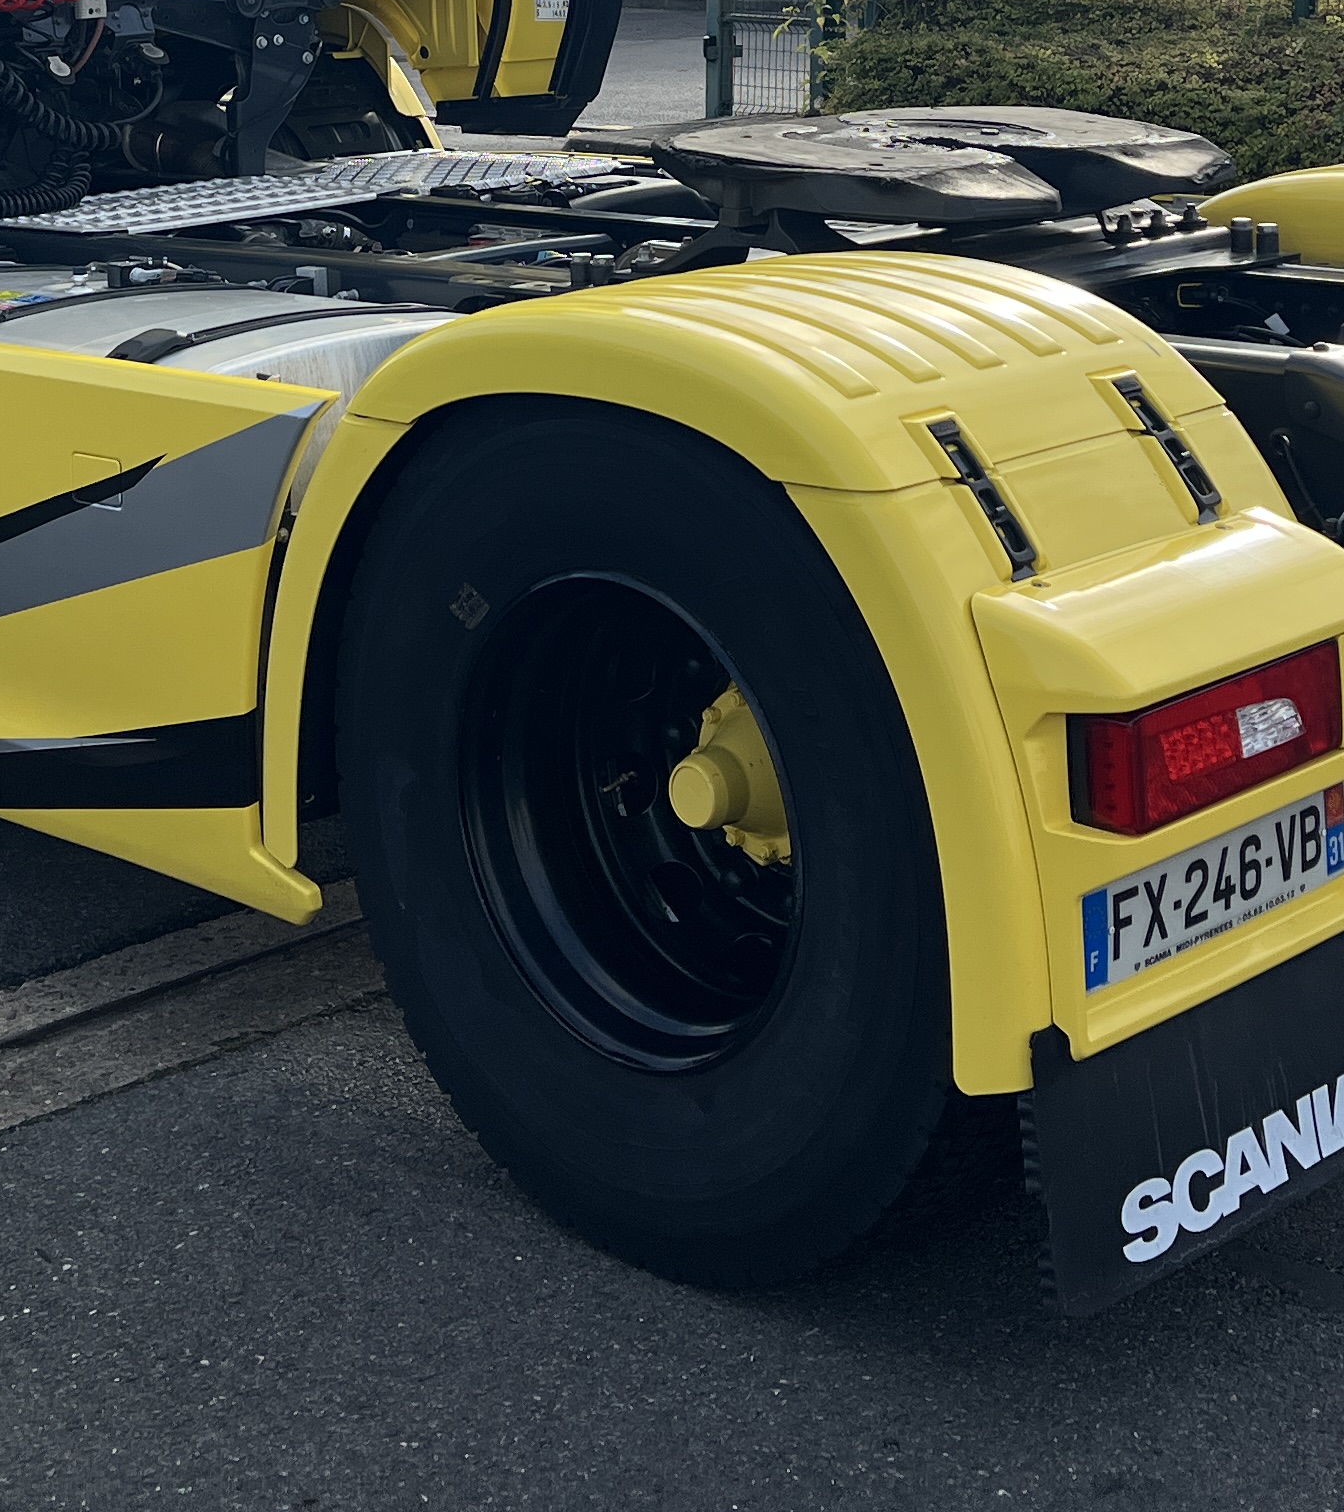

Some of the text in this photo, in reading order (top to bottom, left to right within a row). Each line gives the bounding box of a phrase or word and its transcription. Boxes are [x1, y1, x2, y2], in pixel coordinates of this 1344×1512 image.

[1090, 804, 1344, 972] F FX-246-VB 31
